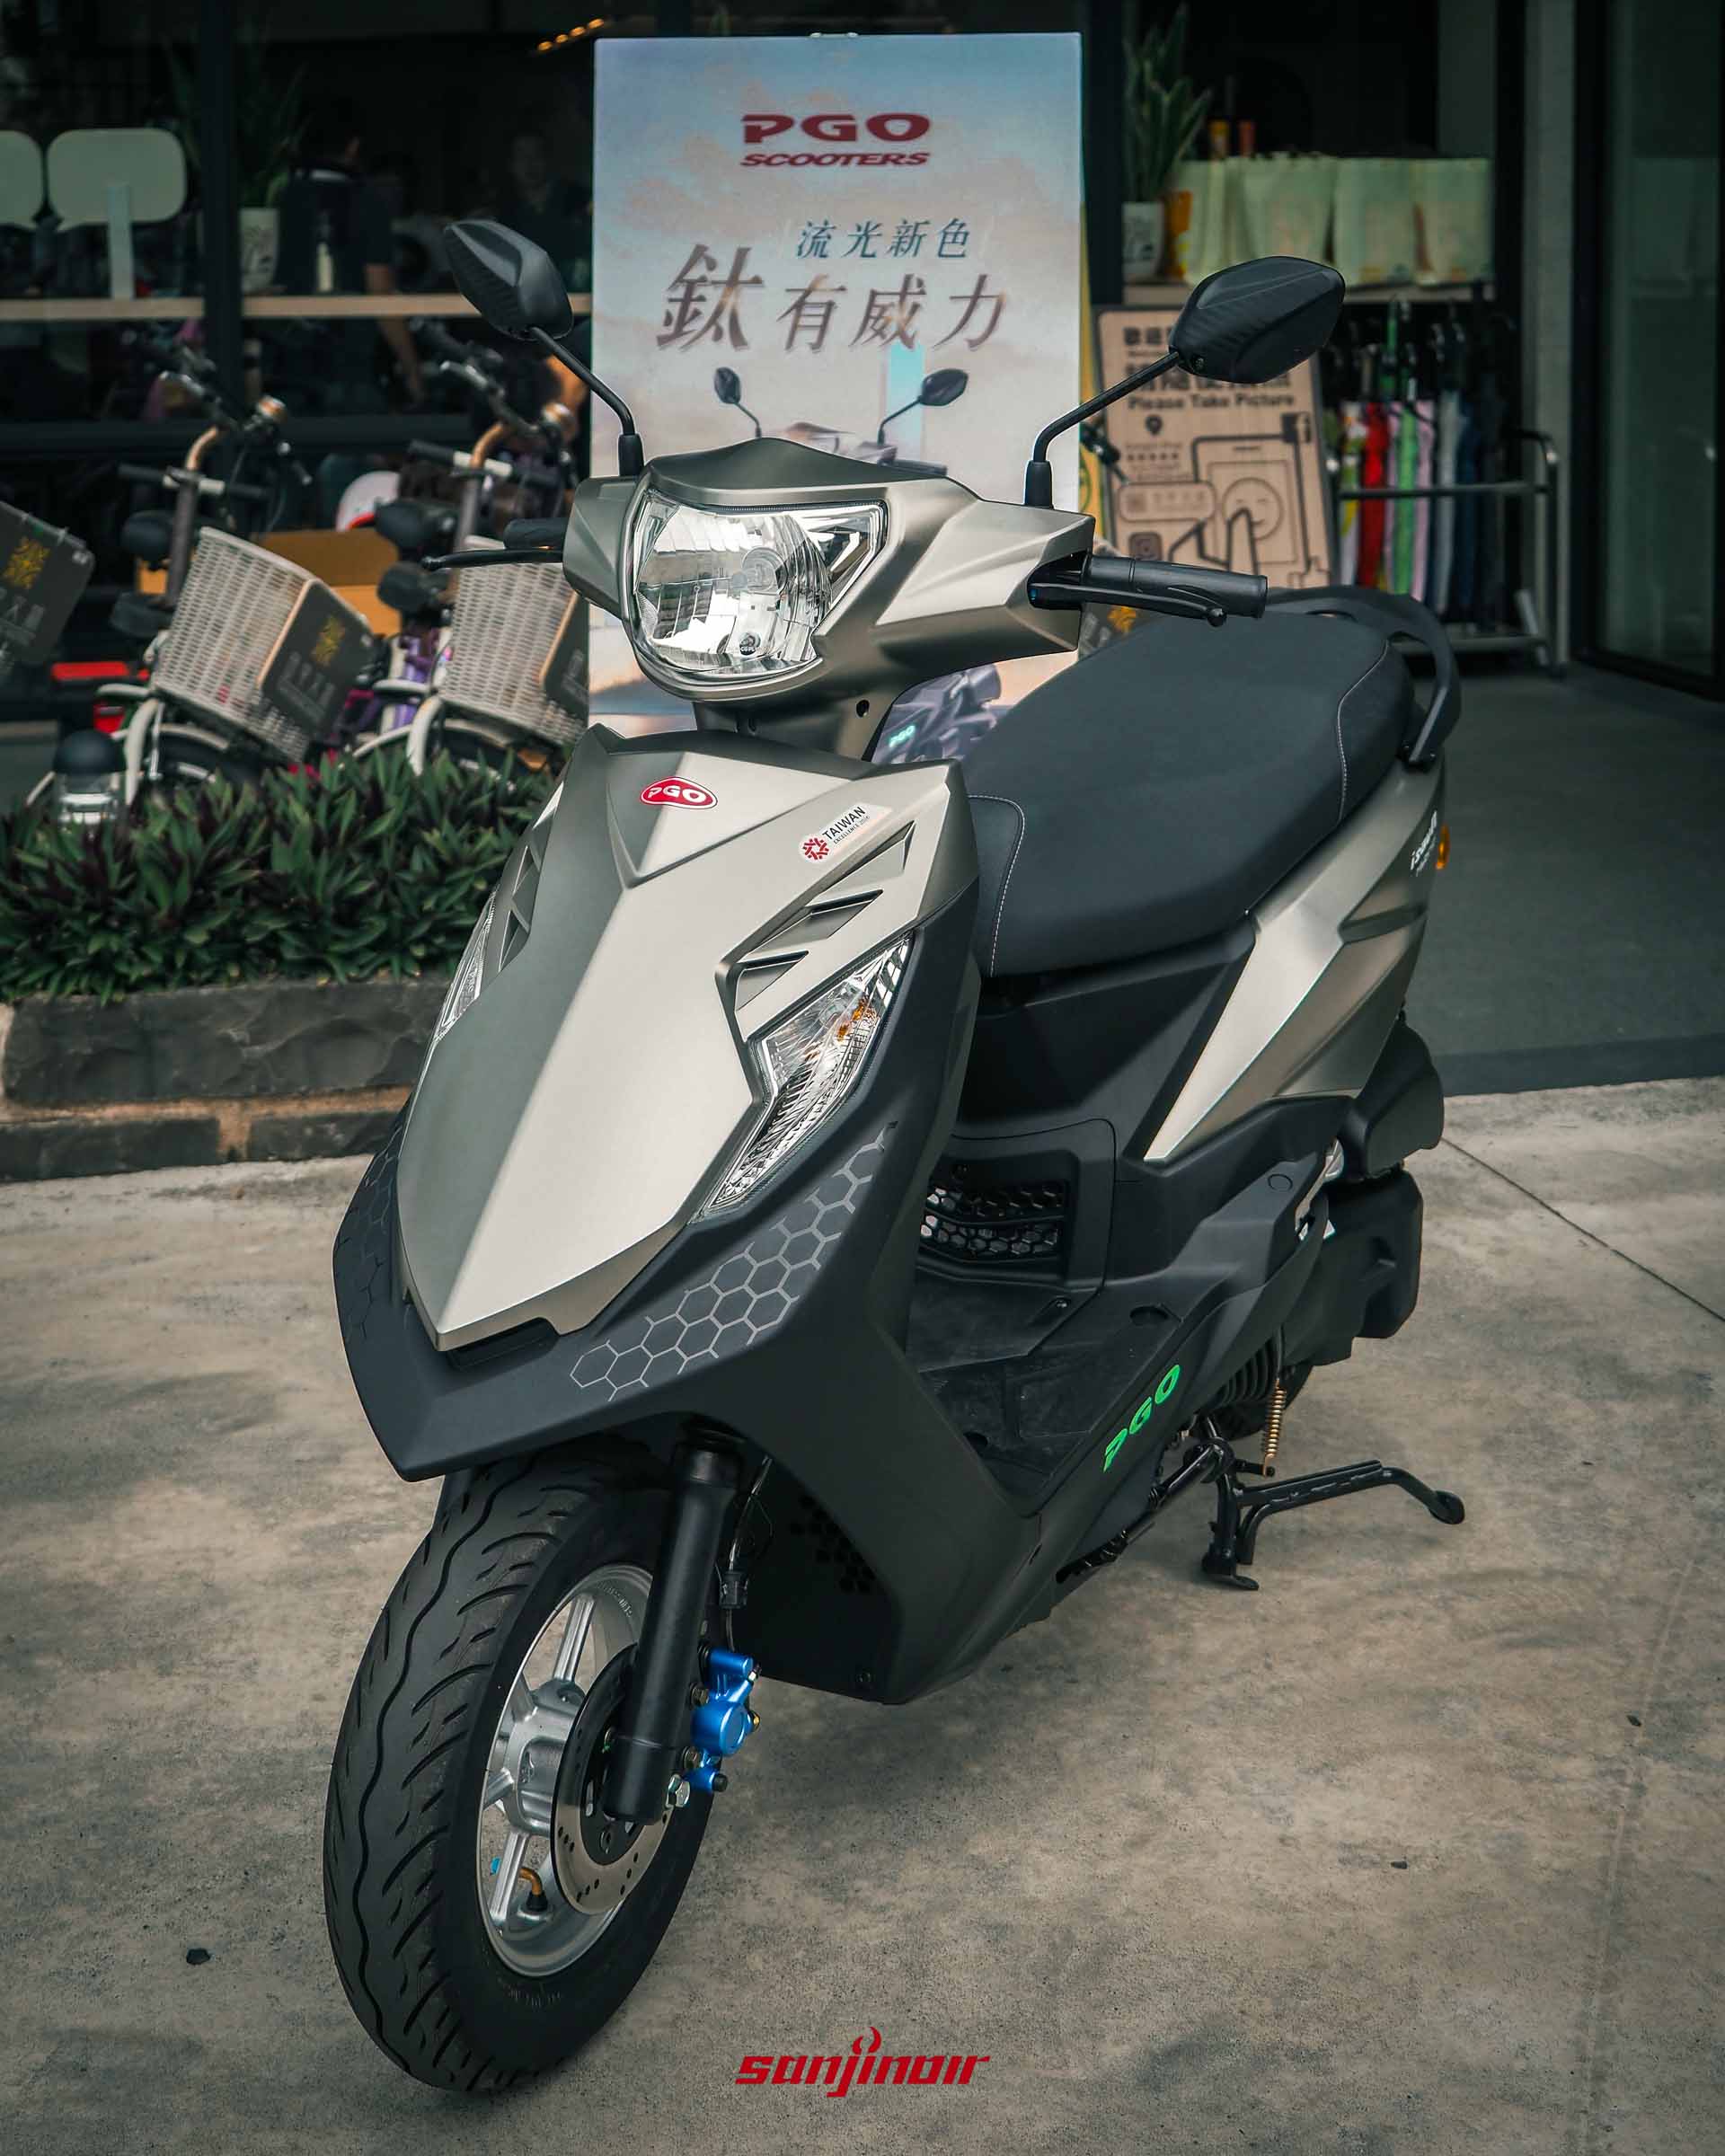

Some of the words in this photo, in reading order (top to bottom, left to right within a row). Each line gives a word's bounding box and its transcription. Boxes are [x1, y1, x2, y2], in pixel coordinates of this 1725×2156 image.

[740, 113, 931, 144] PGO
[740, 152, 931, 167] SCOOTERS
[796, 217, 970, 260] 流光新色
[656, 243, 1009, 352] 鈦有威力
[647, 785, 707, 803] PGO
[821, 806, 865, 841] TAIWAN
[1103, 1364, 1181, 1473] PGO
